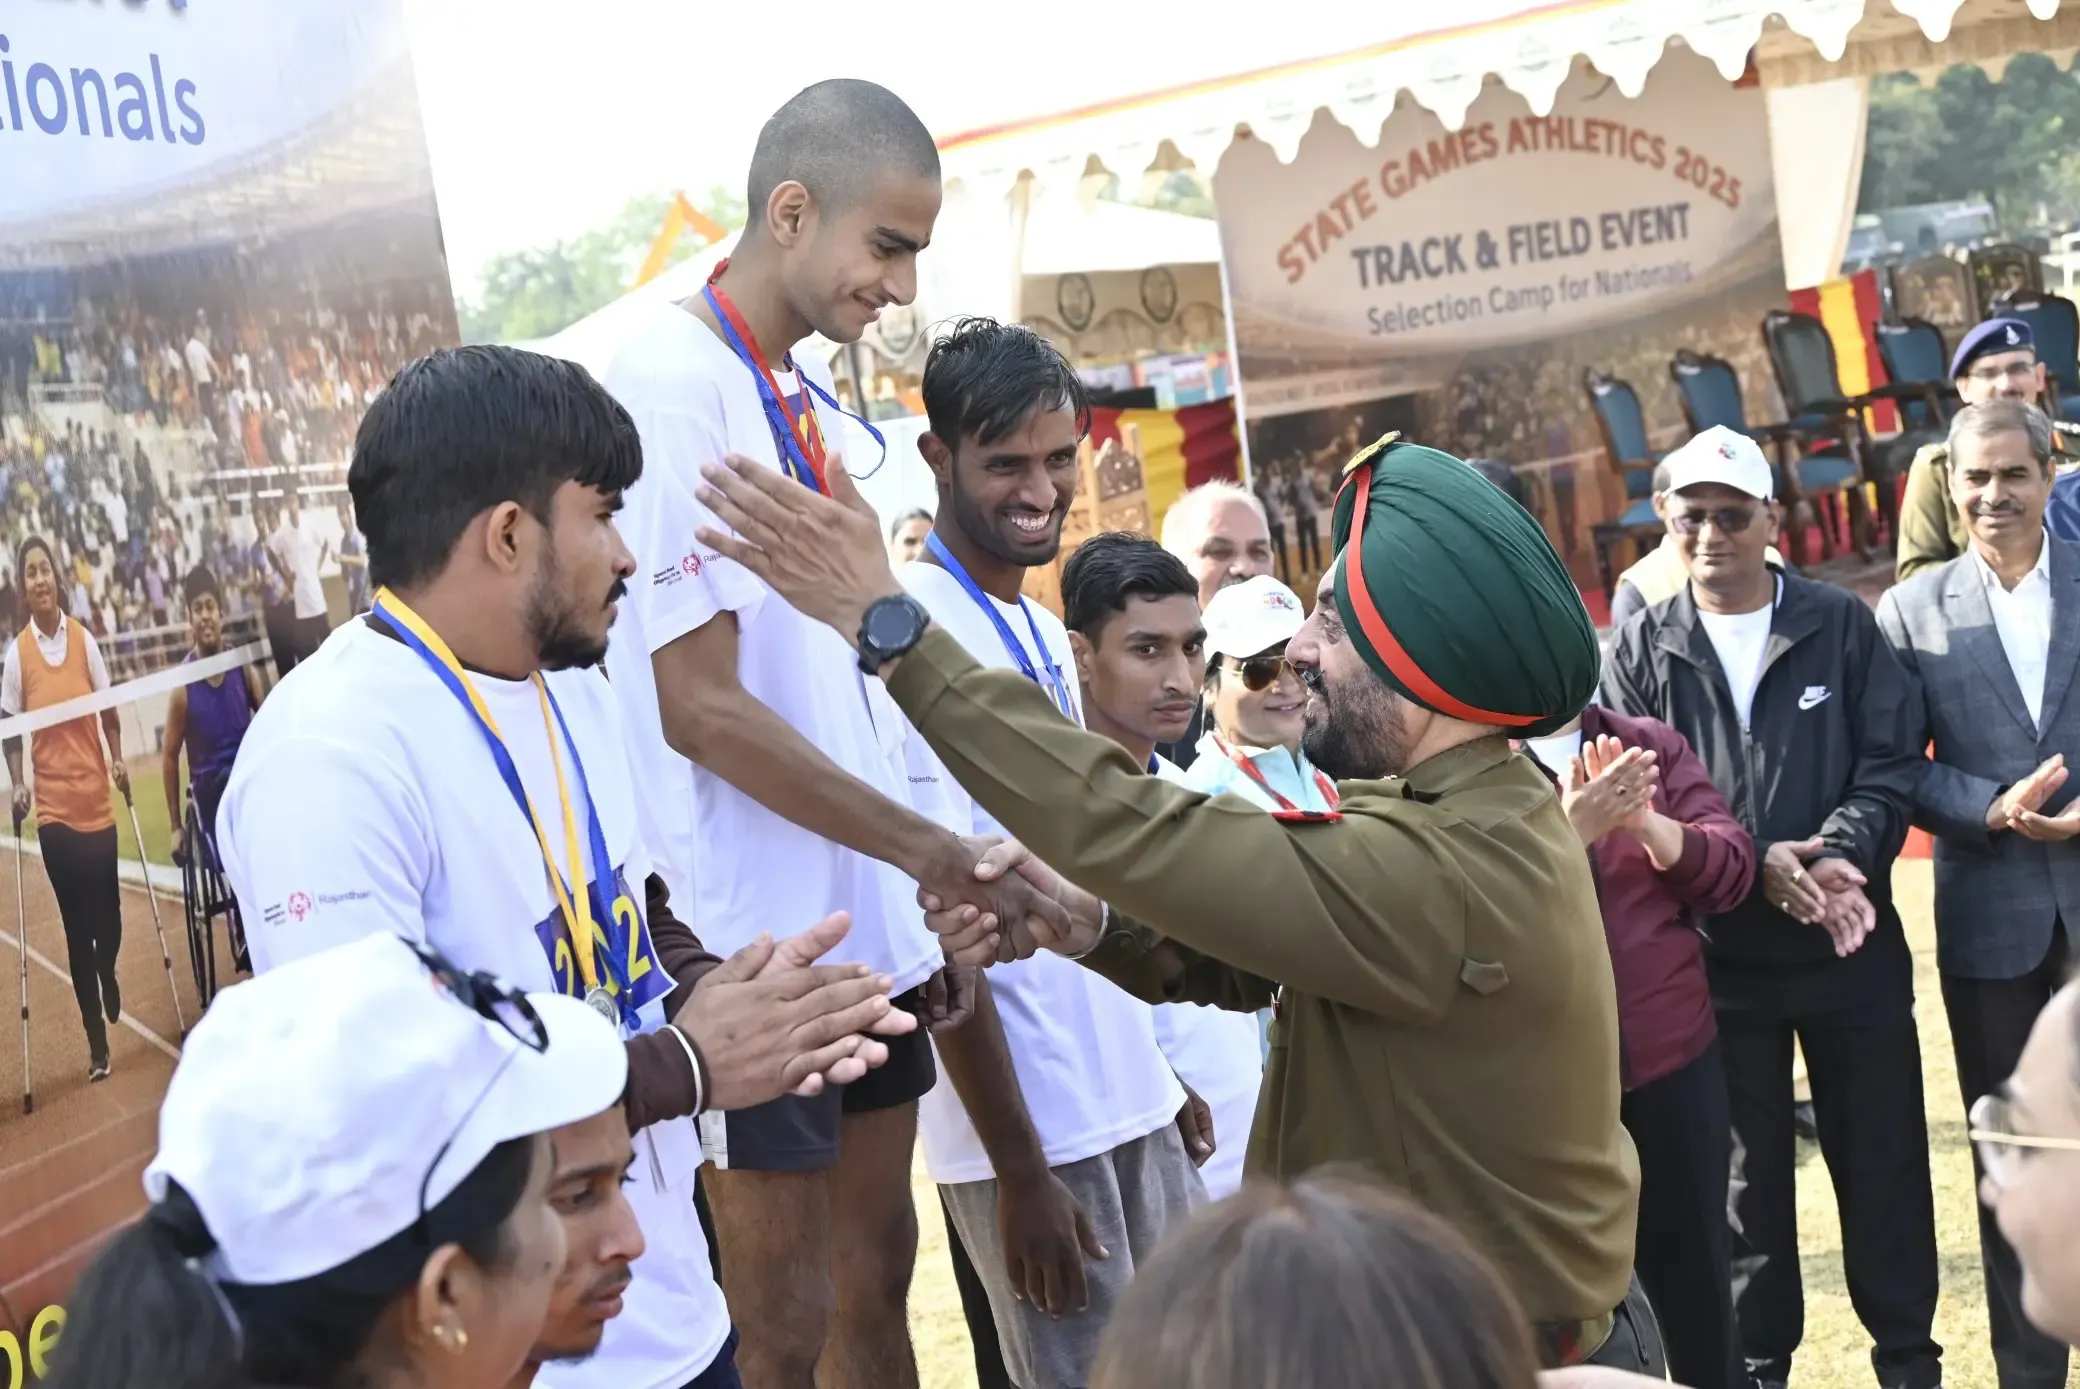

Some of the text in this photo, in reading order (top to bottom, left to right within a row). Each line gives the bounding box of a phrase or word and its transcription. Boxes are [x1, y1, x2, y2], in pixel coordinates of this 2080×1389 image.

[0, 33, 206, 146] ionals
[1276, 116, 1743, 284] STATE GAMES ATHLETICS 2025
[1351, 202, 1690, 289] TRACK & FIELD EVENT
[1367, 258, 1693, 335] Selection Camp for Nationals
[907, 775, 940, 784] Rajasthan
